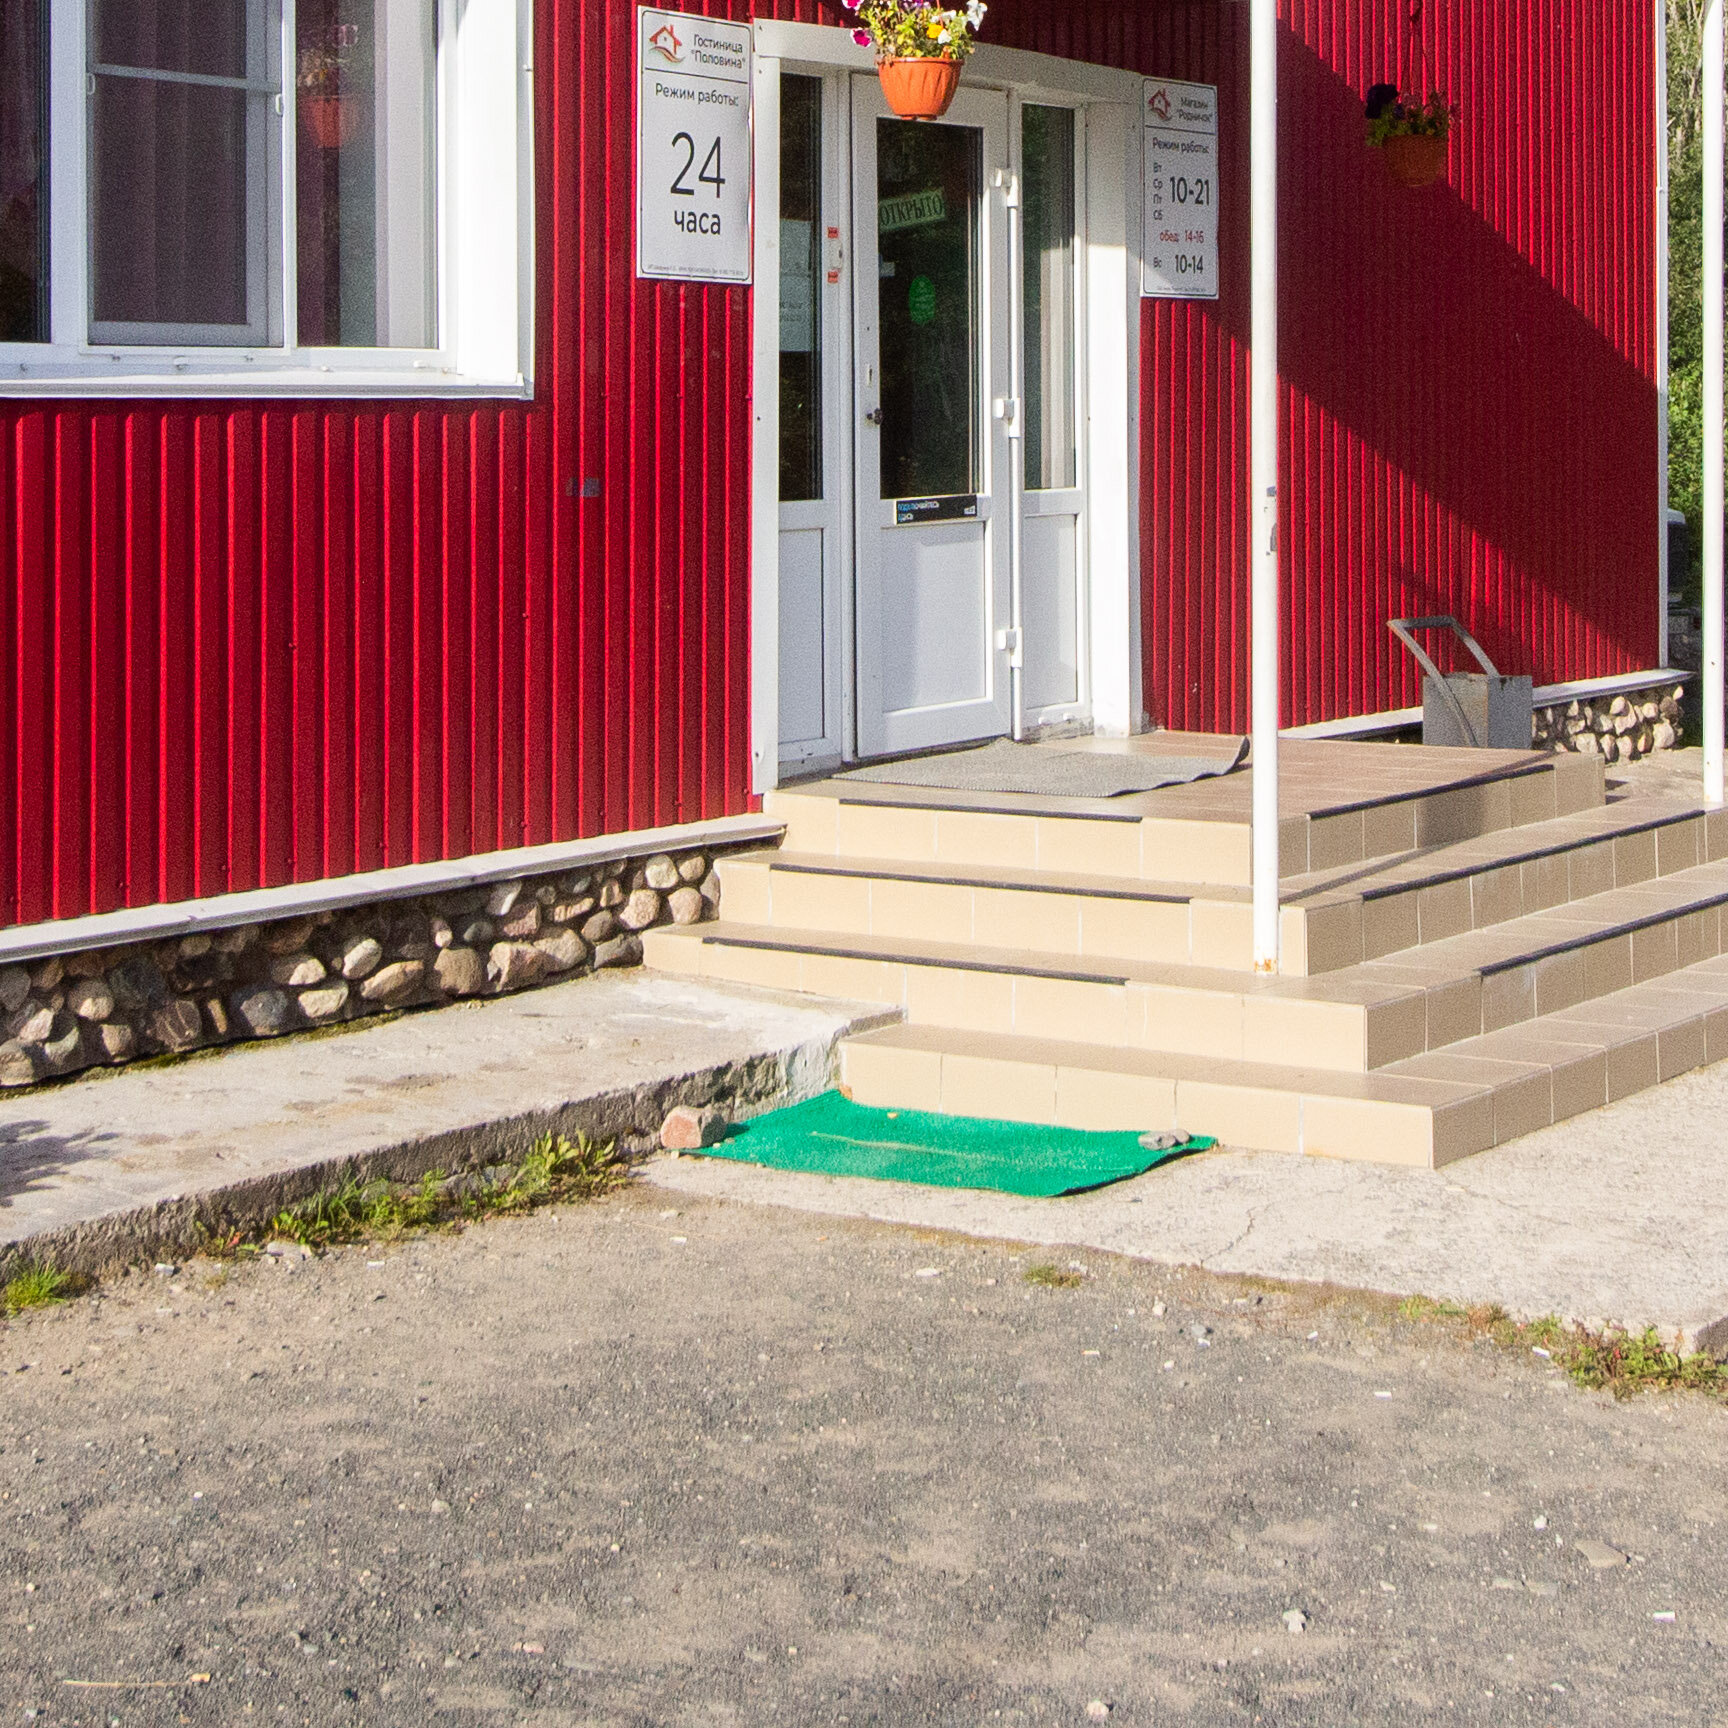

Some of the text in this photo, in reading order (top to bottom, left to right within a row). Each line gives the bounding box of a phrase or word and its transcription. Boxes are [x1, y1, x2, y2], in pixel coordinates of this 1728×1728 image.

[693, 34, 743, 55] Гостиница
[691, 50, 745, 69] "Половина"
[655, 83, 740, 106] Режим работы:
[1152, 137, 1179, 151] Режим
[670, 132, 725, 199] 24
[1170, 176, 1210, 206] 10-21
[879, 192, 943, 225] ОТКРЫТО
[673, 210, 721, 235] часа
[1175, 254, 1204, 274] 10-14
